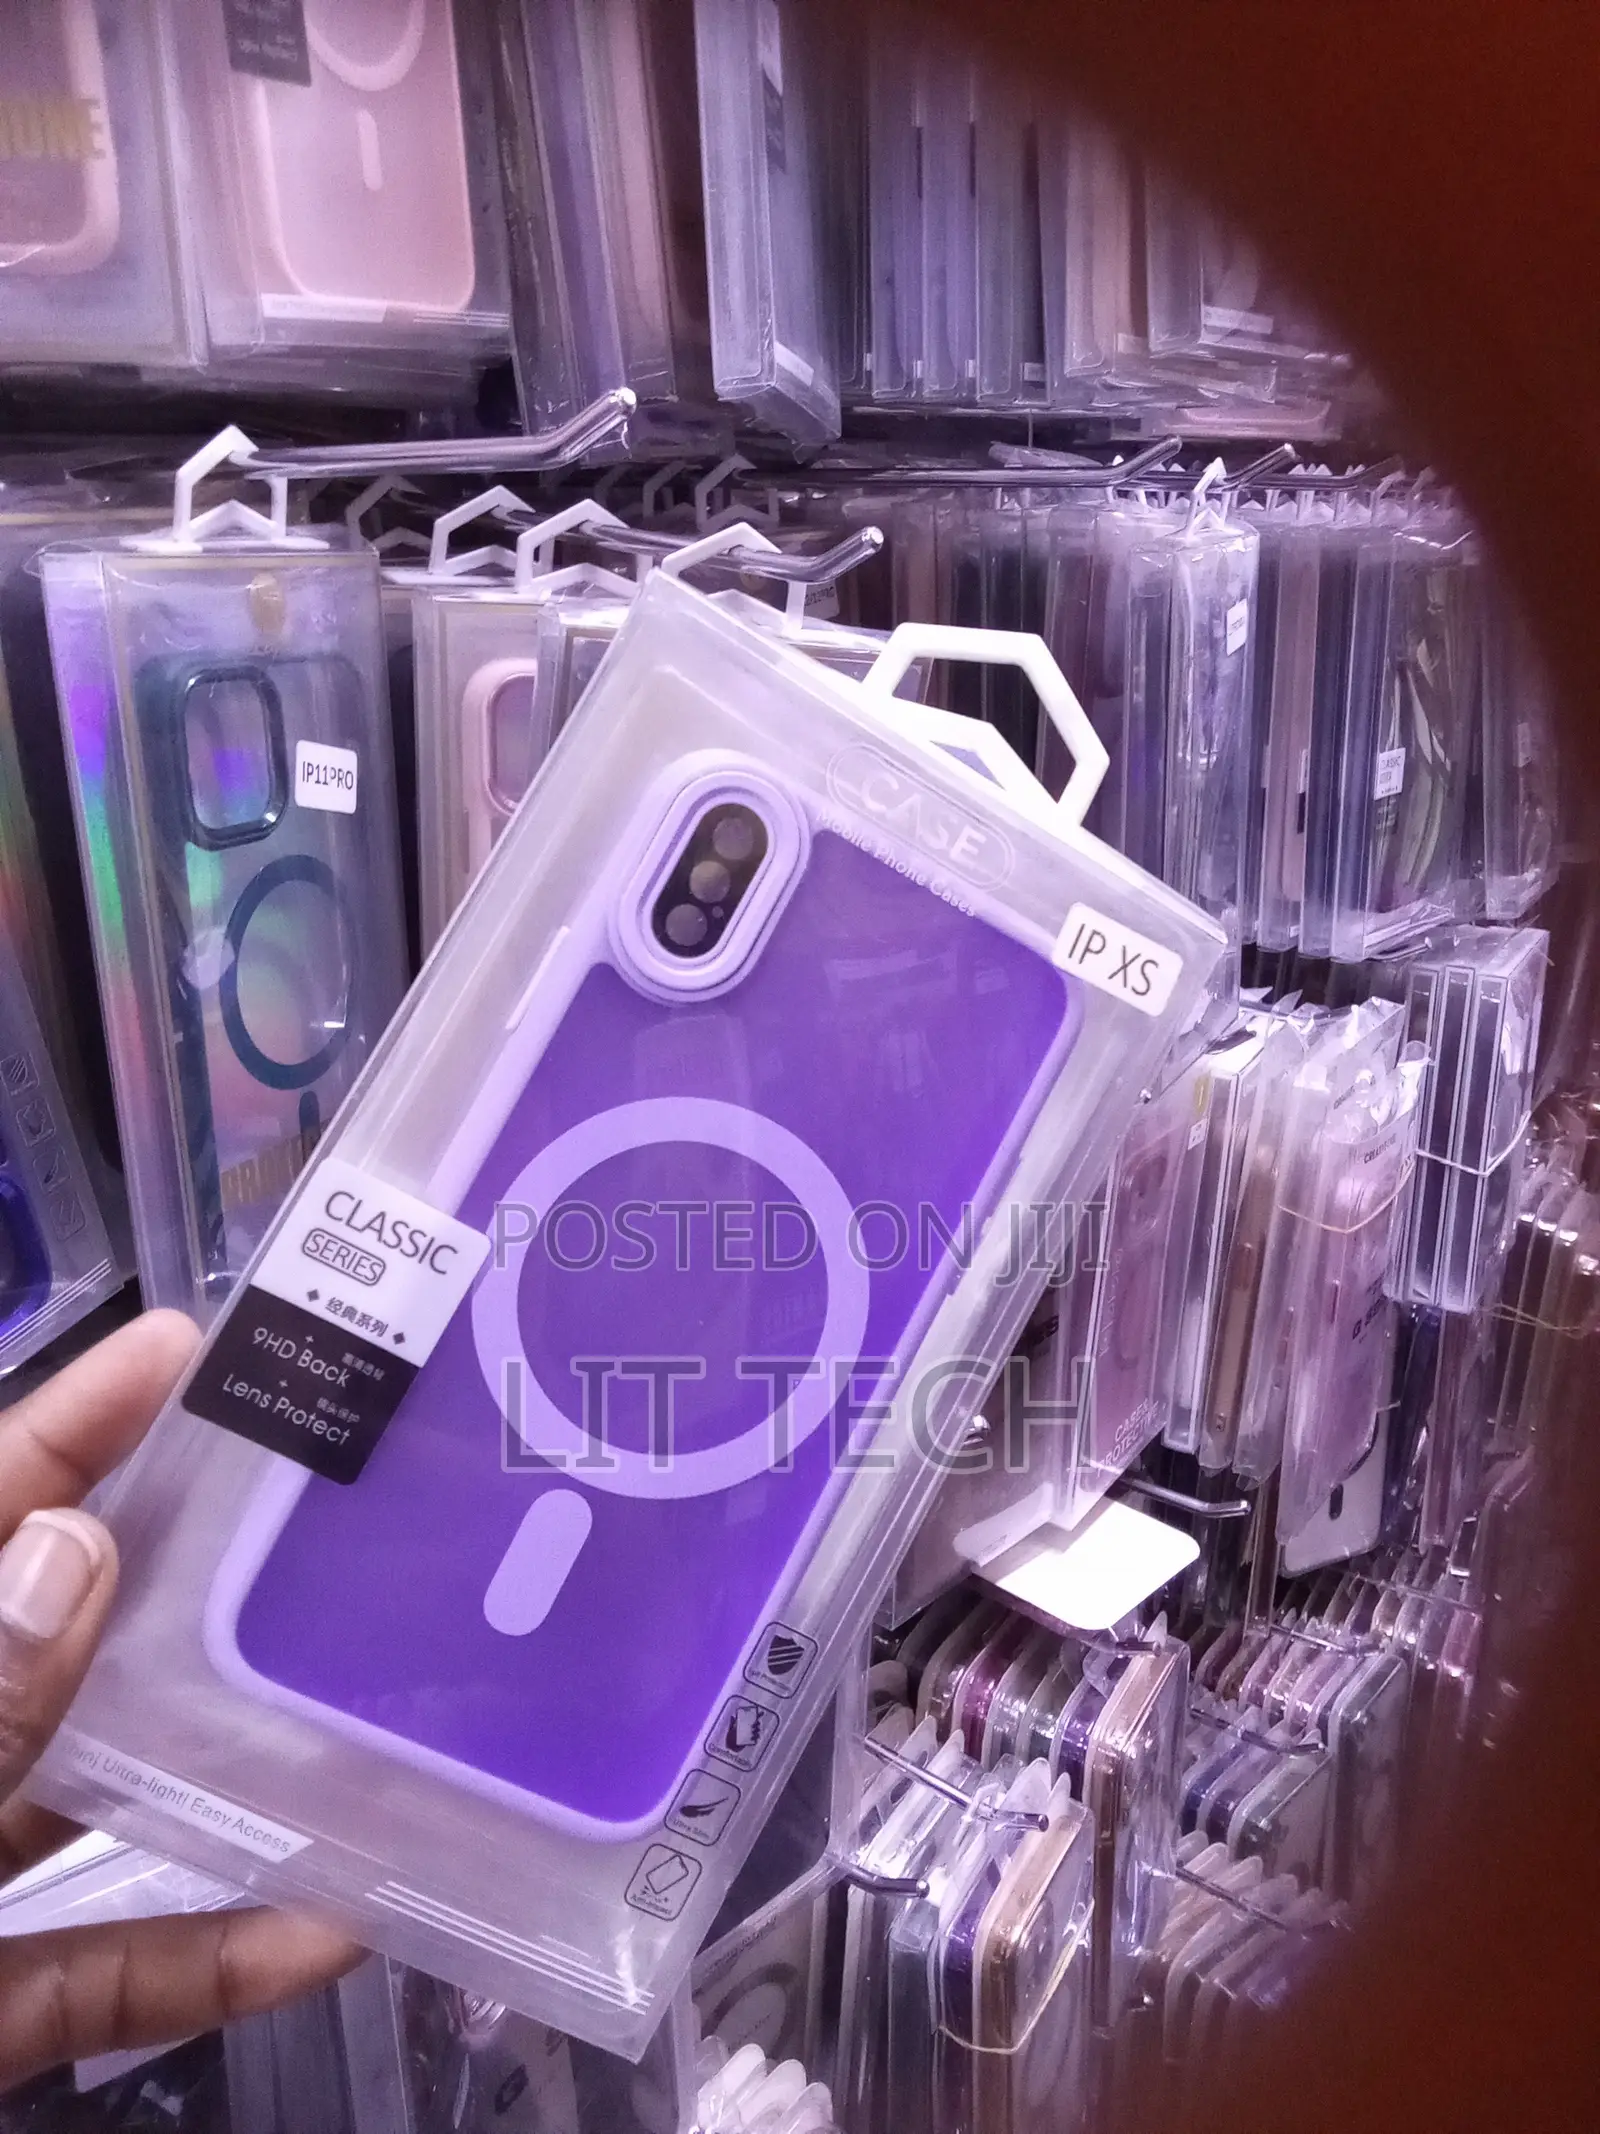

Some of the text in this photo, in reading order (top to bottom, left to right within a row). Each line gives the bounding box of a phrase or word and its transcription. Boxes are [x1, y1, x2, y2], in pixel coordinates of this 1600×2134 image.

[302, 761, 354, 791] IP11PRO
[861, 771, 987, 869] CASE
[873, 845, 927, 886] Phone
[930, 877, 975, 917] Cases
[1068, 923, 1159, 996] IP XS
[306, 1233, 382, 1281] SERIES
[325, 1191, 458, 1275] CLASSIC
[325, 1297, 389, 1338] 经典系列
[253, 1327, 297, 1359] 9HD
[297, 1349, 350, 1388] Back
[223, 1374, 350, 1446] Lens Protect
[190, 1797, 232, 1828] Easy
[232, 1817, 291, 1852] Access
